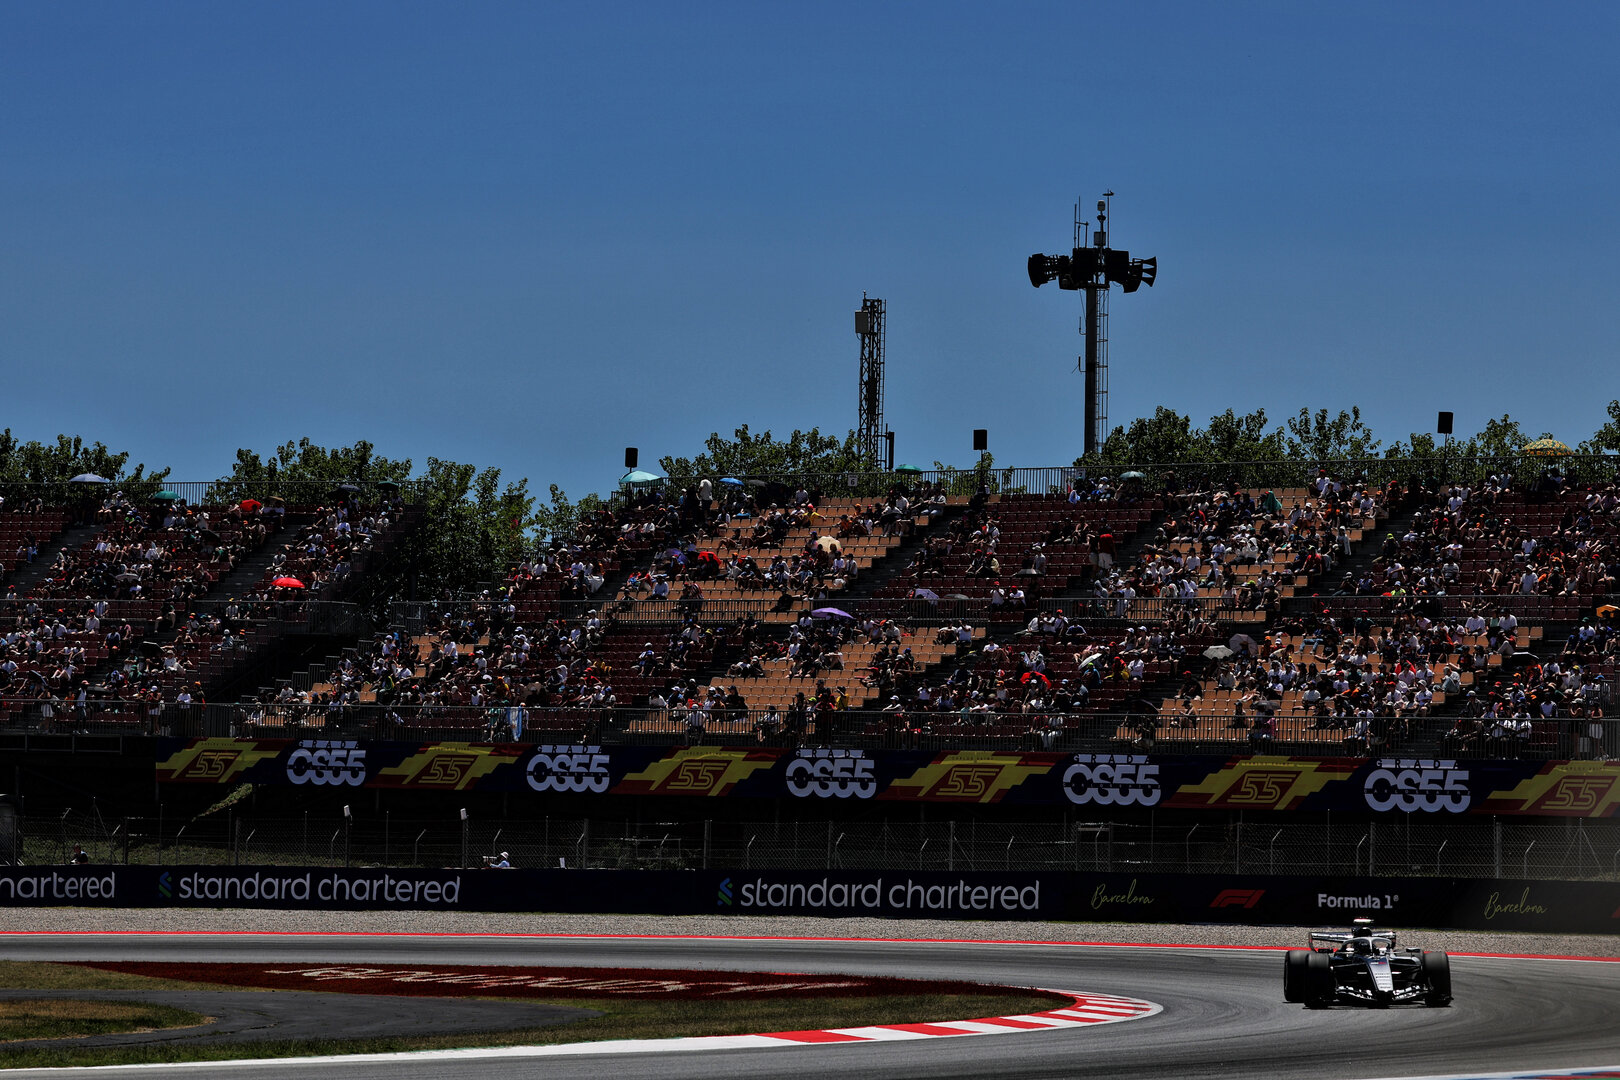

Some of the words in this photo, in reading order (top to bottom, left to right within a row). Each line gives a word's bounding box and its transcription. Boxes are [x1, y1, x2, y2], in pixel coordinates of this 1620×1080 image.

[185, 751, 238, 778] 55
[536, 745, 603, 754] GRADA
[795, 749, 866, 758] GRADA
[1073, 754, 1149, 764] GRADA
[1375, 759, 1459, 769] GRADA
[286, 748, 367, 787] CS55
[418, 757, 474, 784] 55
[526, 754, 610, 793] CS55
[666, 761, 727, 790] 55
[786, 759, 877, 799] CS55
[936, 767, 999, 796] 55
[1063, 764, 1161, 807] CS55
[1227, 772, 1297, 804] 55
[1364, 769, 1471, 813] CS55
[1541, 778, 1613, 811] 55
[178, 871, 312, 901] standard
[317, 873, 462, 904] chartered
[740, 878, 882, 909] standard
[889, 880, 1040, 911] chartered
[1090, 879, 1155, 909] Barcelona
[1317, 893, 1381, 909] Formula
[1484, 886, 1548, 920] Barcelona
